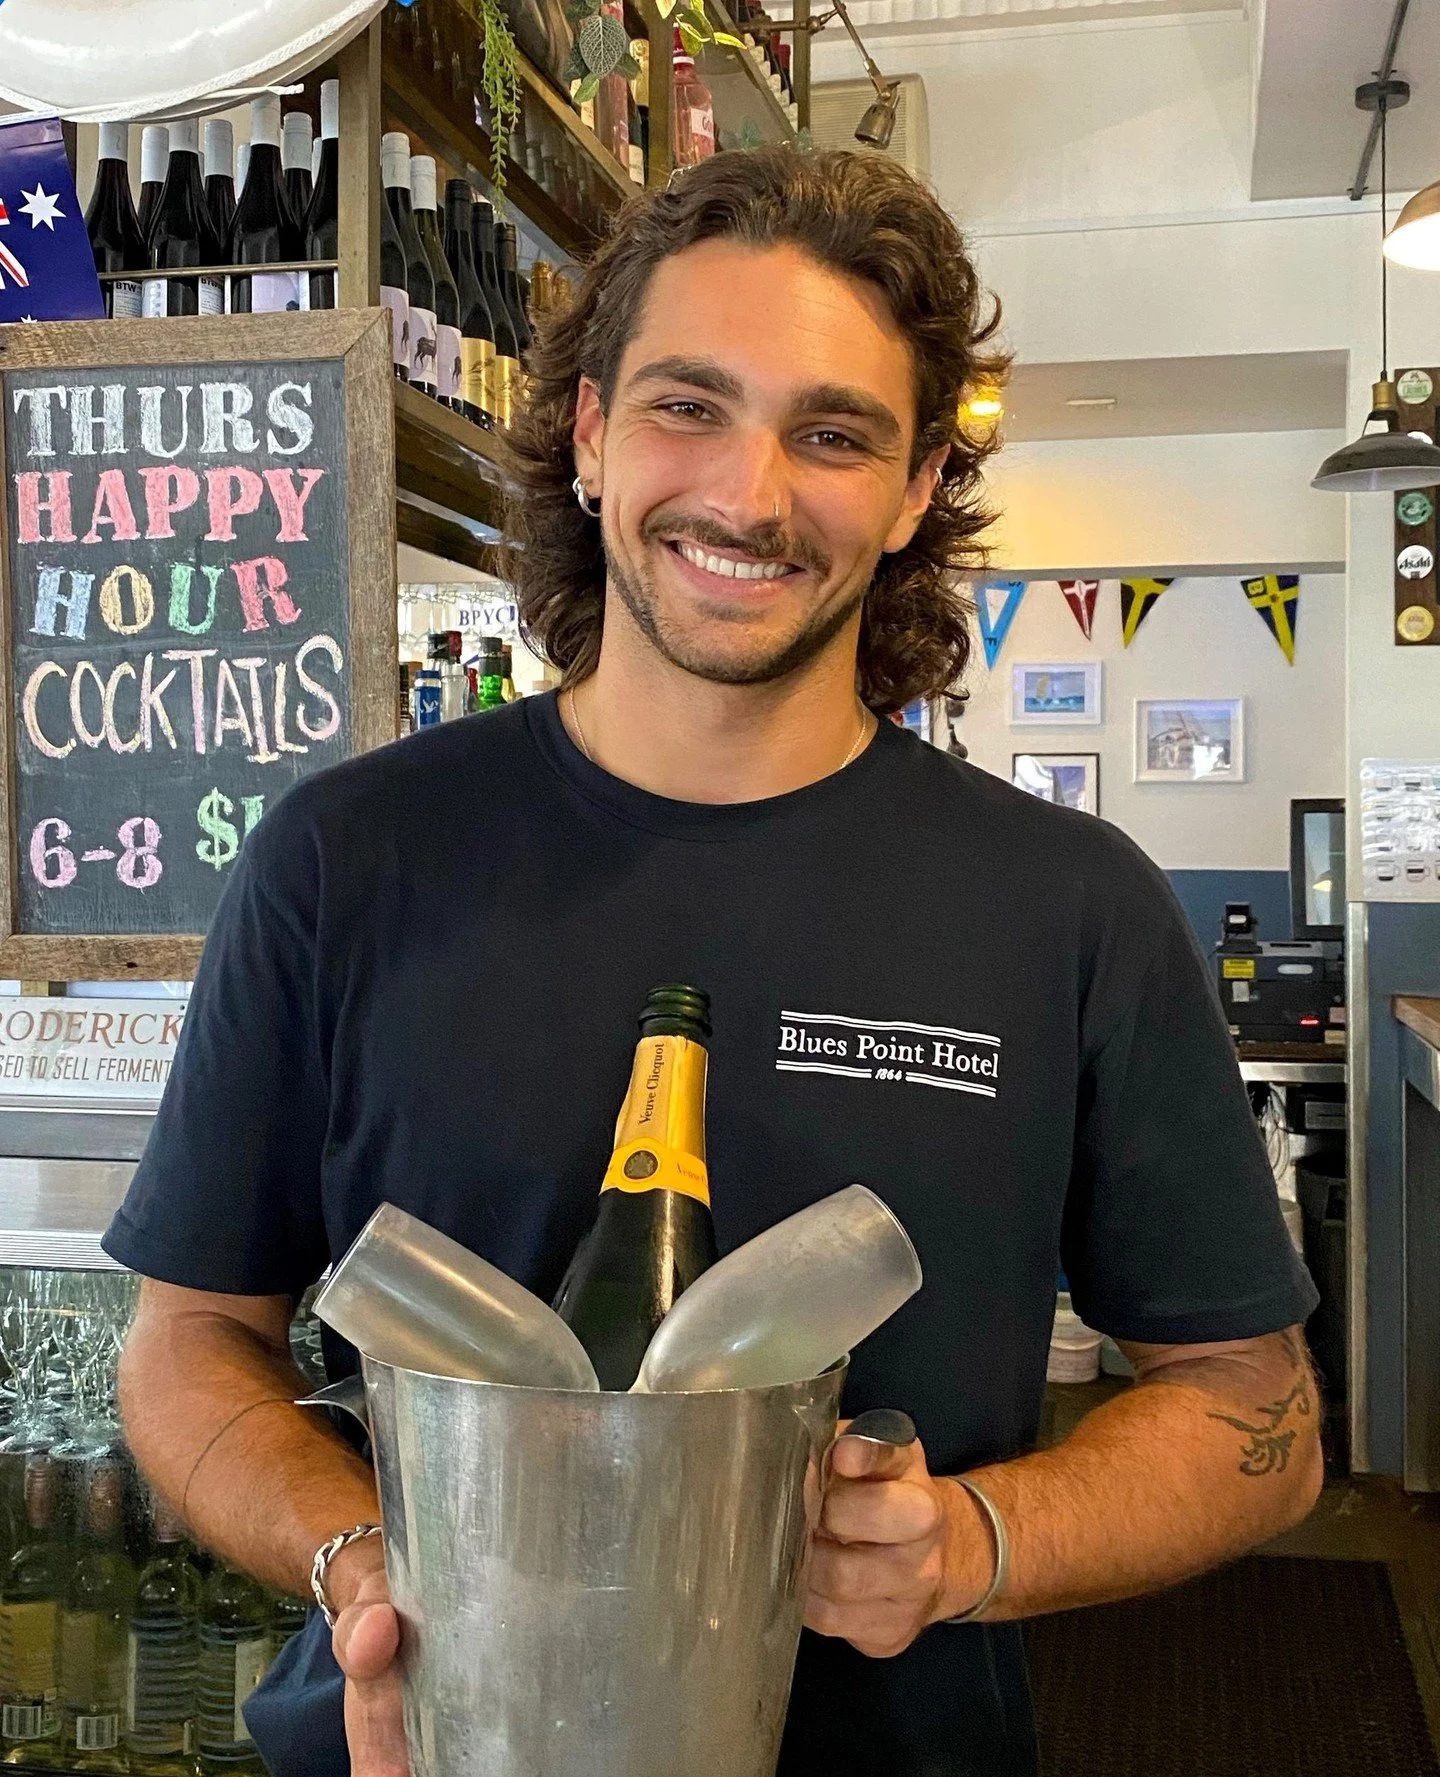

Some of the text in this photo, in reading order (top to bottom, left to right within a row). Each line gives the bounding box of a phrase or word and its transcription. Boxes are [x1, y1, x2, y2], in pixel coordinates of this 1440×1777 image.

[115, 281, 137, 293] BTW
[13, 381, 315, 458] THURS
[14, 465, 325, 544] HAPPY
[1399, 556, 1431, 569] Asahi
[29, 555, 301, 640] HOUR
[23, 634, 343, 764] COCKTAILS
[30, 817, 163, 888] 6-8
[0, 1010, 184, 1049] ODERICK
[778, 1026, 999, 1078] Blues Point Hotel
[29, 1055, 48, 1079] TO
[53, 1056, 90, 1081] SELL
[638, 1042, 665, 1126] Veuve Clicquot
[874, 1068, 903, 1081] 1864
